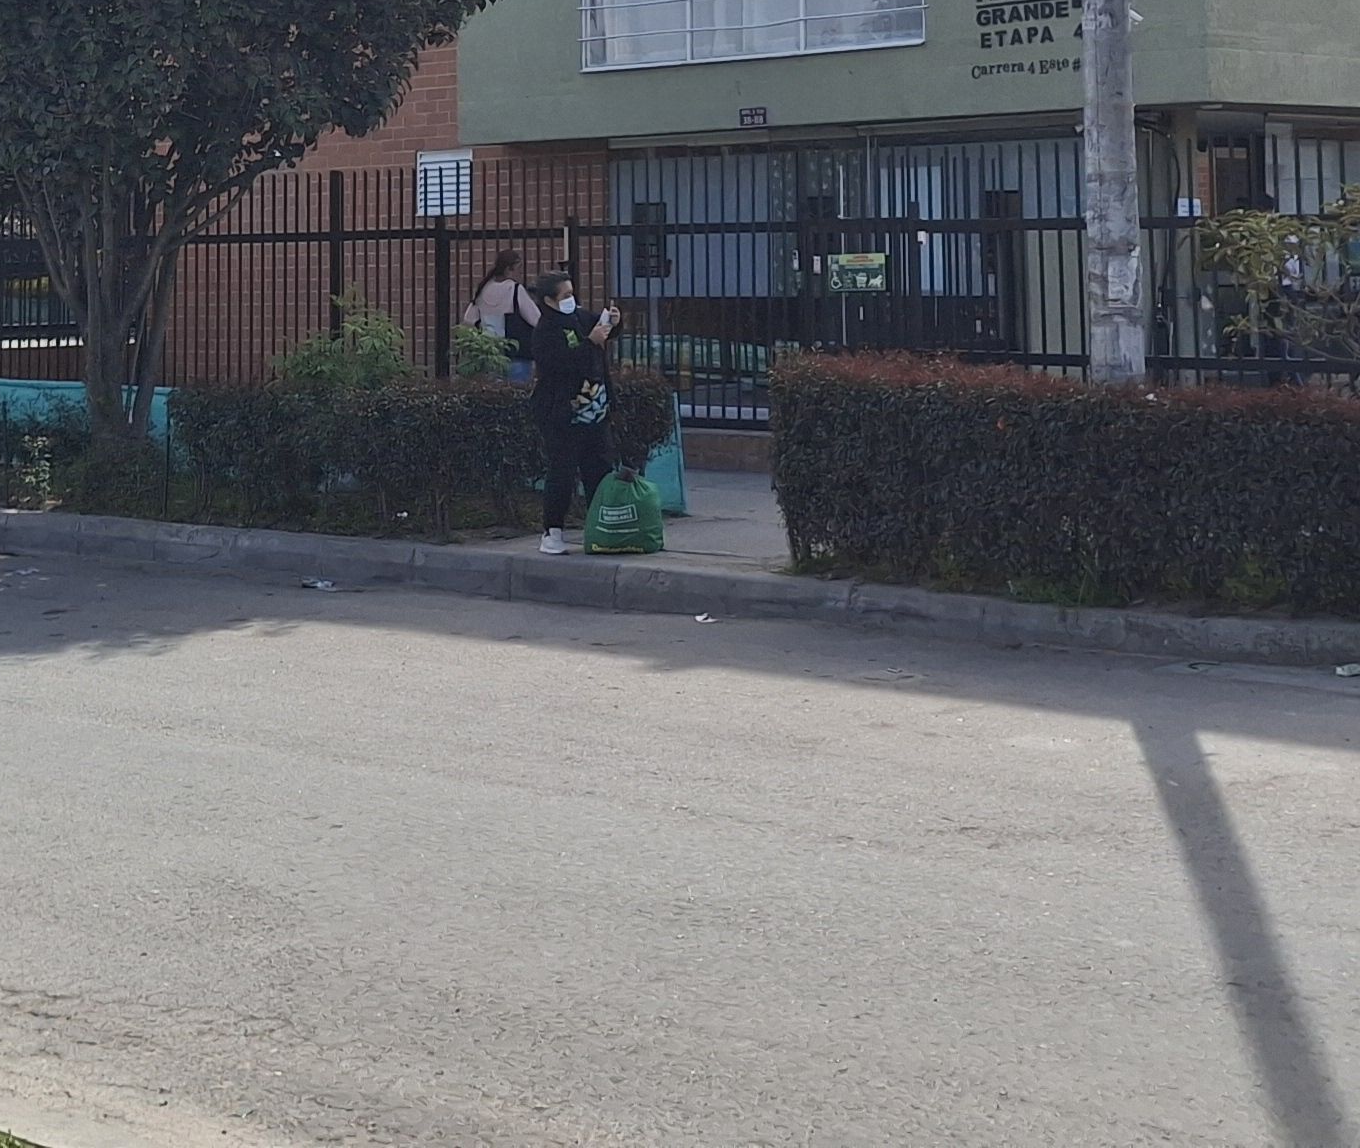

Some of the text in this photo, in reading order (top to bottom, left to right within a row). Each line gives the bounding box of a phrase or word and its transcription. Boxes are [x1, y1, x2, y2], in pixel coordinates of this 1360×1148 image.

[976, 0, 1069, 26] GRANDE
[980, 25, 1054, 49] ETAPA
[971, 62, 1025, 79] Carrera
[1027, 61, 1036, 75] 4
[1039, 57, 1070, 75] Este
